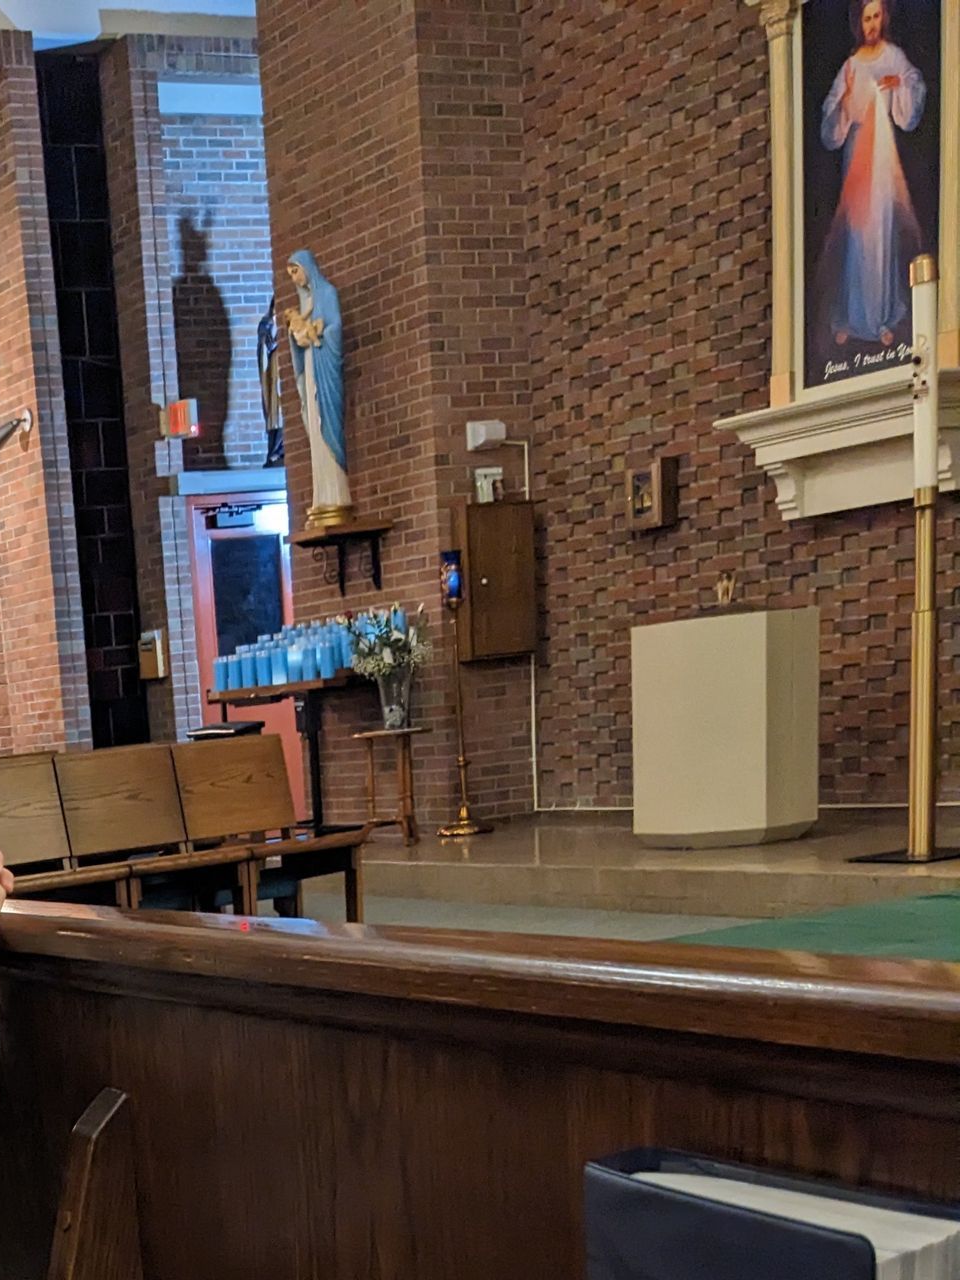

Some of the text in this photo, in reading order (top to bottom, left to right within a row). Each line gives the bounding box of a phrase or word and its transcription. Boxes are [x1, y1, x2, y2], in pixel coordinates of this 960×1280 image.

[824, 342, 913, 380] Jesus, I trust in Yo
